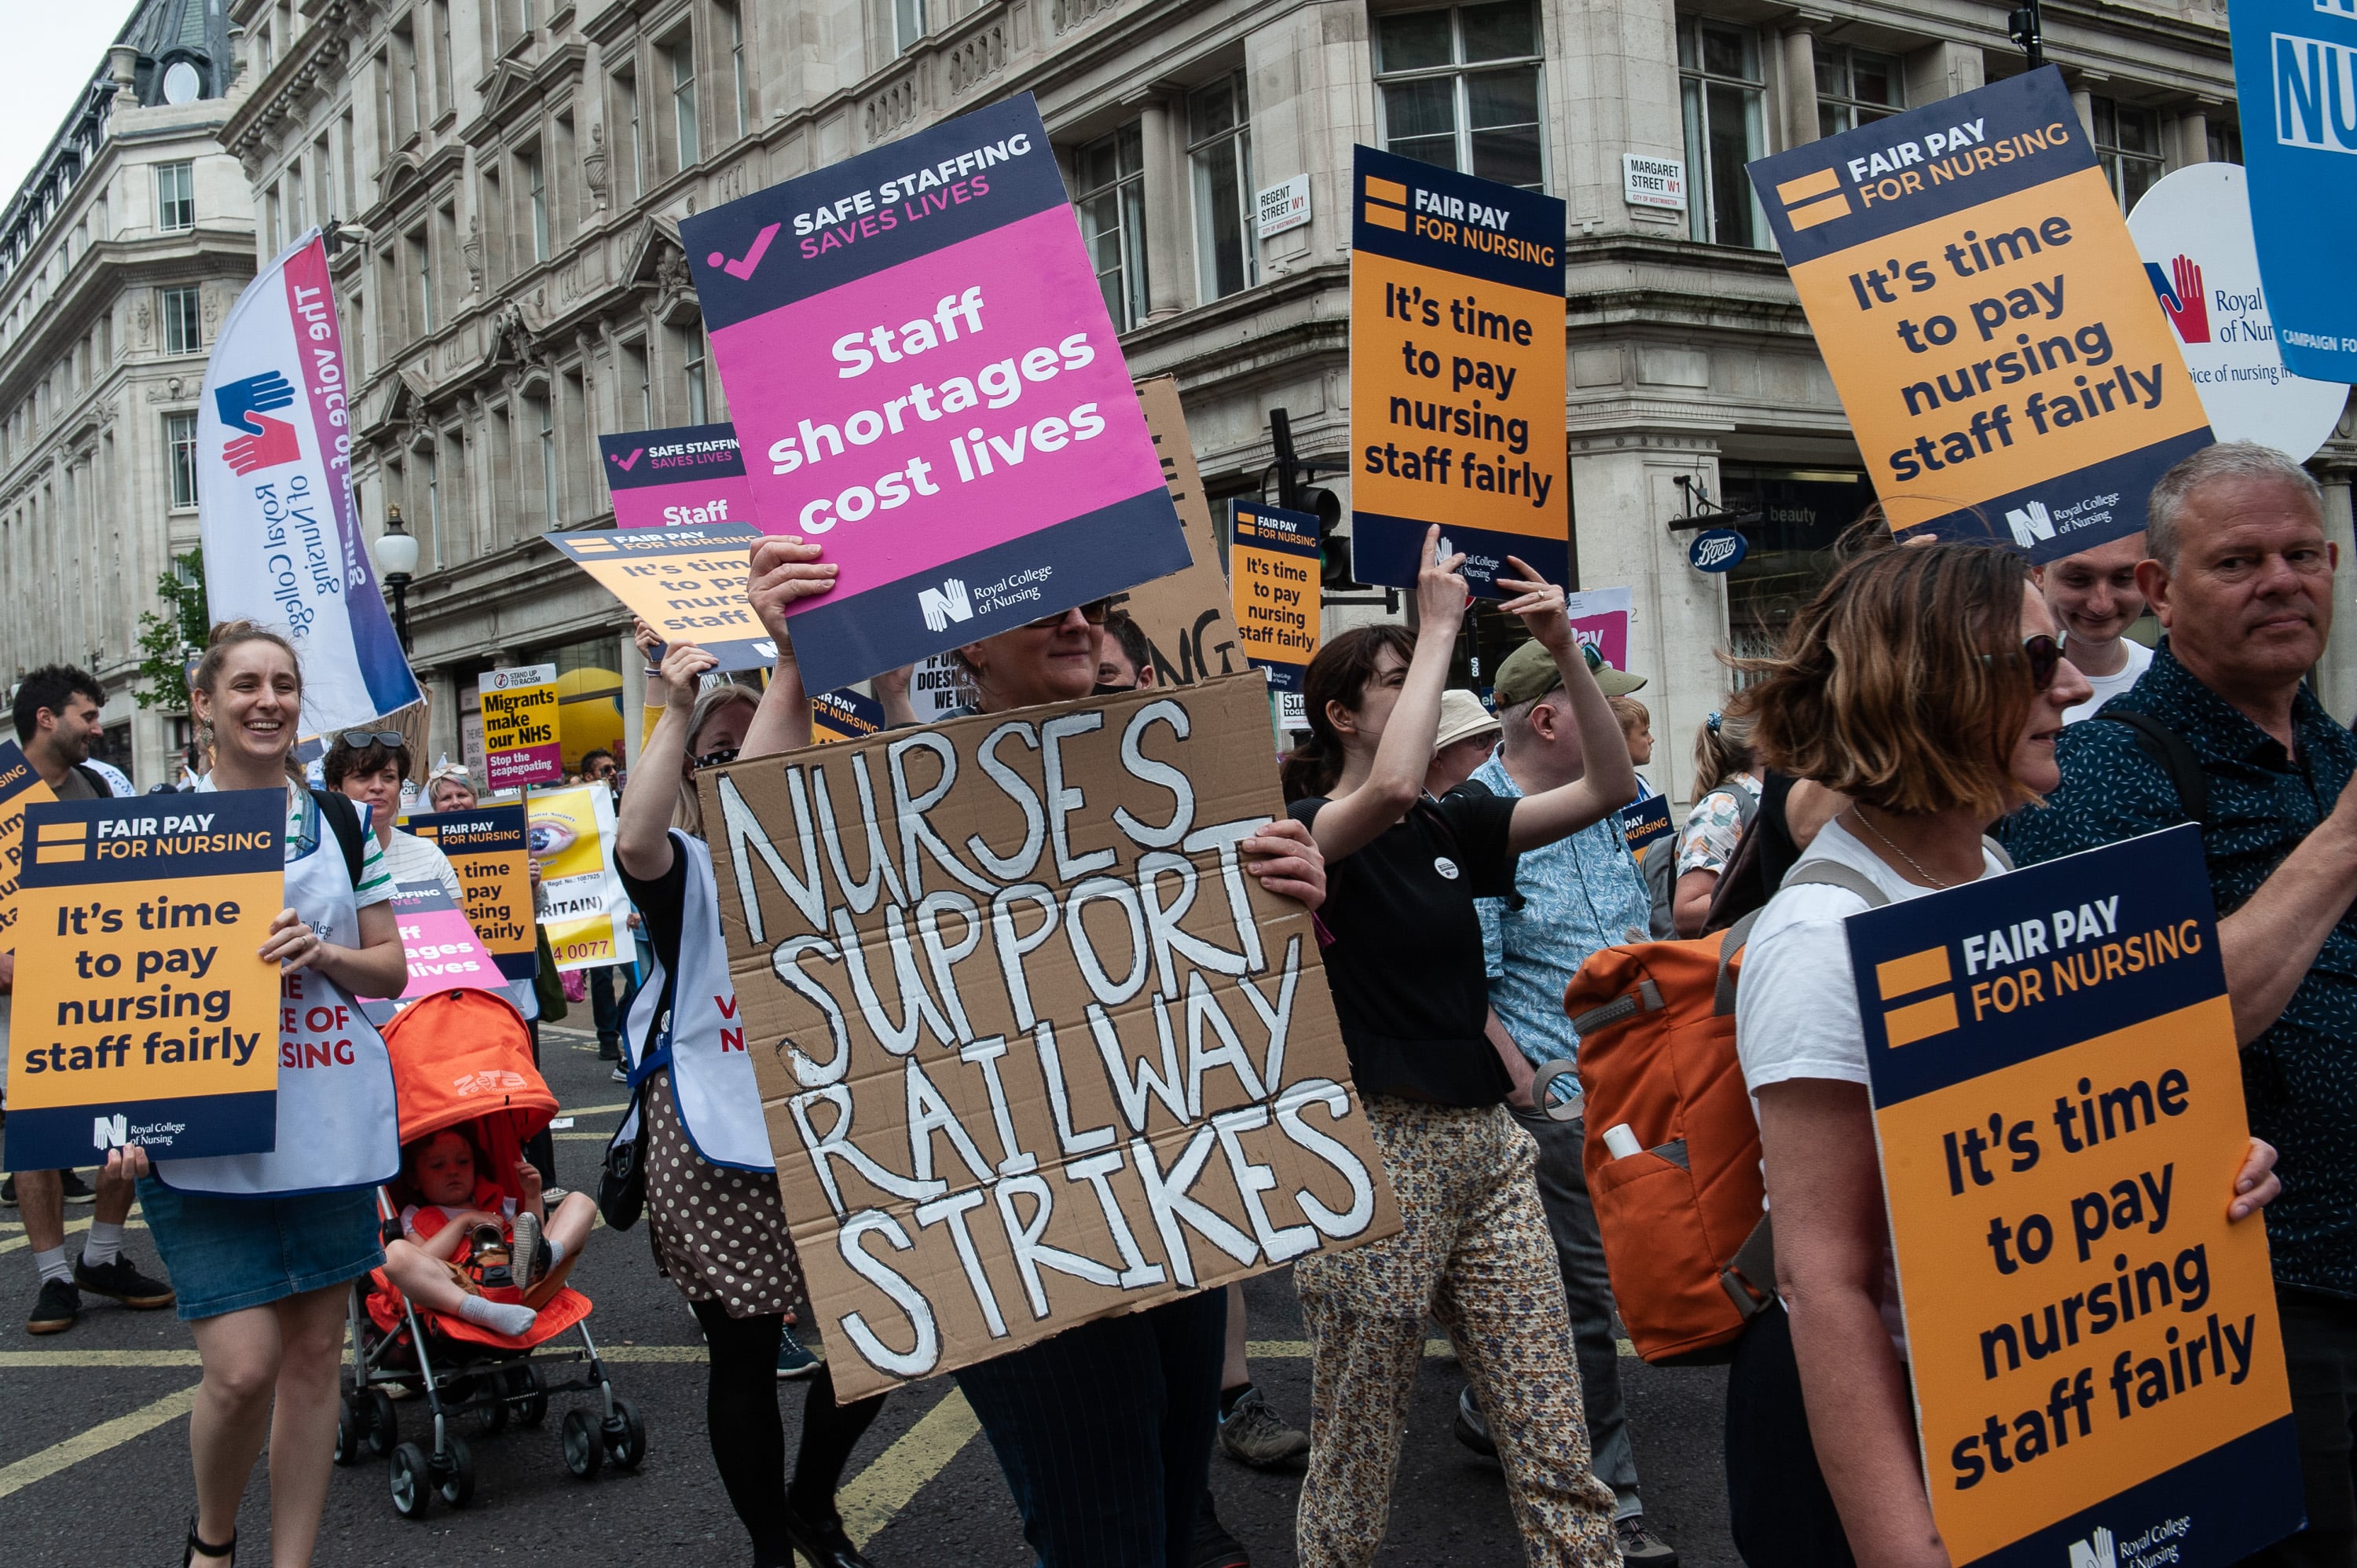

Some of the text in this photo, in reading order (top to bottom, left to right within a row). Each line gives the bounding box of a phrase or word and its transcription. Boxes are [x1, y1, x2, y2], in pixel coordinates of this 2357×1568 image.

[1848, 118, 1986, 184] FAIR PAY
[1631, 159, 1678, 178] MARGARET
[1859, 122, 2070, 209] FOR NURSING
[793, 132, 1032, 236] SAFE STAFFING
[1261, 185, 1290, 207] REGENT
[1632, 174, 1680, 193] STREET W1
[1262, 195, 1304, 222] STREET W1
[1415, 189, 1510, 231] FAIR PAY
[1649, 197, 1677, 206] WESTMINSTER
[800, 174, 990, 260] SAVES LIVES
[1277, 216, 1301, 229] WESTMINSTER
[1415, 214, 1555, 267] FOR NURSING
[1848, 214, 2073, 313] It's time
[1386, 282, 1534, 346] It's time
[1897, 273, 2065, 355] to pay
[2216, 288, 2263, 319] Royal
[831, 285, 985, 379] Staff
[2220, 319, 2237, 343] of
[2282, 329, 2338, 351] CAMPAIGN
[1402, 340, 1517, 401] to pay
[1901, 321, 2113, 418] nursing
[2215, 365, 2279, 385] of nursing
[767, 332, 1096, 476] shortages
[1390, 396, 1529, 455] nursing
[1889, 362, 2163, 482] staff fairly
[649, 444, 685, 458] SAFE
[651, 451, 733, 469] SAVES LIVES
[798, 454, 940, 536] cost
[949, 401, 1106, 482] lives
[1365, 442, 1553, 509] staff fairly
[663, 500, 728, 526] Staff
[1770, 506, 1816, 526] beauty
[2053, 493, 2120, 522] Royal College
[1258, 516, 1297, 533] FAIR PAY
[2059, 511, 2112, 533] of Nursing
[614, 531, 706, 544] FAIR PAY
[623, 540, 669, 550] FOR
[1258, 528, 1316, 548] FOR NURSING
[1475, 555, 1499, 570] College
[1695, 536, 1736, 566] Boots
[973, 566, 1052, 601] Royal College
[1273, 561, 1307, 582] time
[1464, 566, 1490, 582] Nursing
[659, 581, 701, 591] to
[1253, 581, 1300, 606] to pay
[979, 586, 1041, 614] of Nursing
[664, 610, 751, 630] staff
[1248, 606, 1305, 629] nursing
[1238, 625, 1314, 653] staff fairly
[510, 671, 528, 680] STAND
[519, 676, 541, 684] RACISM
[484, 689, 555, 713] Migrants
[834, 696, 856, 714] PAY
[934, 691, 953, 709] WE
[487, 713, 530, 731] make
[489, 732, 515, 749] our
[519, 724, 552, 745] NHS
[490, 752, 530, 768] Stop the
[491, 760, 552, 777] scapegoating
[97, 813, 215, 838] FAIR PAY
[442, 821, 494, 834] FAIR PAY
[717, 700, 1193, 943] NURSES
[1624, 814, 1644, 831] PAY
[1626, 817, 1668, 843] NURSING
[97, 831, 272, 860] FOR NURSING
[442, 830, 520, 845] FOR NURSING
[464, 862, 510, 877] time
[577, 873, 600, 882] 1087925
[467, 885, 502, 902] pay
[57, 902, 123, 937] It's
[136, 895, 241, 930] time
[475, 922, 525, 941] fairly
[1963, 895, 2121, 975] FAIR PAY
[567, 940, 609, 960] 0077
[771, 816, 1277, 1087] SUPPORT
[75, 946, 218, 983] to pay
[407, 961, 481, 978] lives
[1970, 919, 2201, 1021] FOR NURSING
[57, 984, 231, 1026] nursing
[305, 1006, 350, 1033] OF
[25, 1026, 261, 1075] staff fairly
[788, 933, 1303, 1218] RAILWAY
[130, 1122, 185, 1136] Royal College
[141, 1134, 173, 1145] Nursing
[1941, 1068, 2190, 1196] It's time
[838, 1077, 1376, 1379] STRIKES
[1987, 1163, 2176, 1275] to pay
[1978, 1242, 2213, 1380] nursing
[1950, 1313, 2256, 1490] staff fairly
[2120, 1515, 2190, 1559] Royal College
